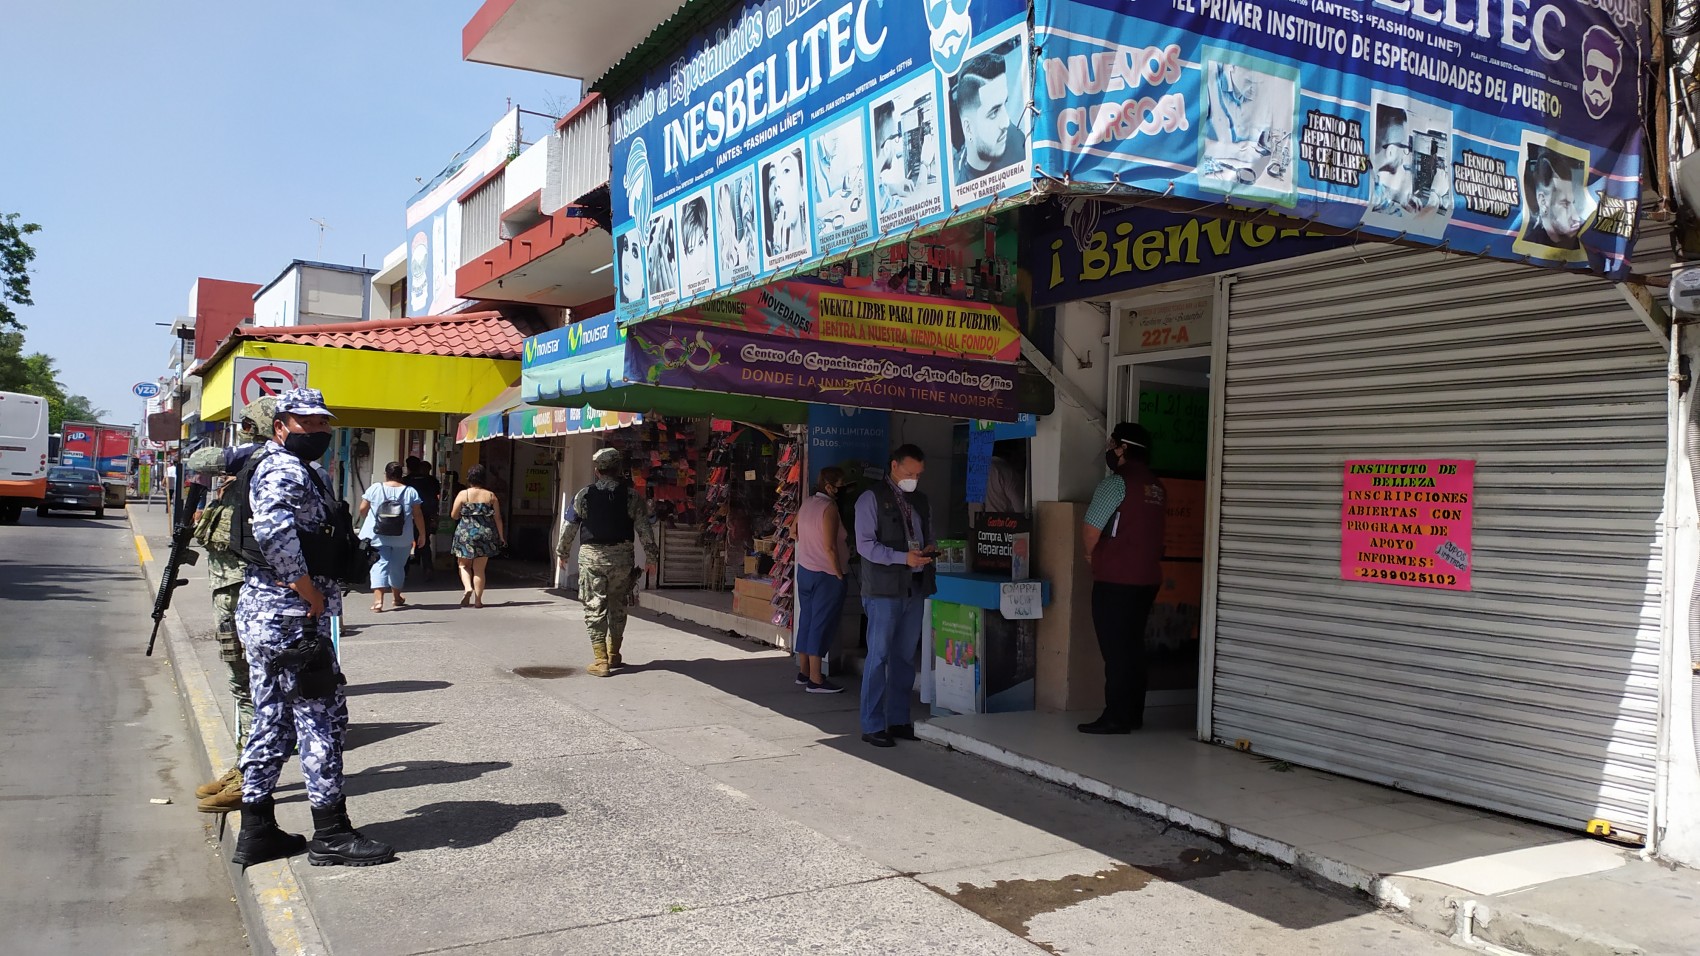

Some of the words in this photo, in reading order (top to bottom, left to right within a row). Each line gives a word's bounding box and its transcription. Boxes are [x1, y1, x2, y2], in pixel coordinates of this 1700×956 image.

[766, 5, 782, 39] en
[1311, 0, 1363, 23] (ANTES:
[1366, 14, 1424, 43] “FASHION
[1427, 33, 1462, 58] LINE”)
[1200, 0, 1262, 32] PRIMER
[1267, 9, 1347, 55] INSTITUTO
[1351, 33, 1371, 62] DE
[1373, 41, 1482, 96] ESPECIALIDADES
[1485, 75, 1508, 103] DEL
[1512, 82, 1562, 118] PUERTO!
[663, 0, 888, 176] INESBELLTEC
[1057, 93, 1189, 147] CURSOS!
[1308, 112, 1346, 136] TÉCNICO
[1349, 122, 1360, 139] EN
[716, 145, 742, 168] (ANTES:
[1301, 143, 1314, 160] DE
[1309, 161, 1315, 177] Y
[1318, 163, 1358, 186] TABLETS
[1463, 151, 1495, 173] TÉCNICO
[1496, 161, 1505, 176] EN
[956, 182, 979, 196] TÉCNICO
[980, 180, 988, 188] EN
[988, 164, 1025, 185] PELUQUERÍA
[978, 181, 1006, 197] BARBERÍA
[1504, 177, 1518, 191] DE
[1455, 179, 1519, 205] COMPUTADORAS
[898, 209, 904, 217] EN
[934, 196, 941, 204] DE
[1466, 195, 1472, 209] Y
[1473, 197, 1510, 217] LAPTOPS
[880, 215, 916, 232] COMPUTADORAS
[919, 206, 941, 219] LAPTOPS
[758, 291, 813, 334] ¡NOVEDADES!
[820, 297, 853, 317] ¡VENTA
[856, 302, 886, 320] LIBRE
[889, 304, 913, 324] PARA
[917, 307, 943, 326] TODO
[946, 310, 957, 328] EL
[959, 312, 1001, 332] PUBLICO!
[582, 324, 610, 345] movistar
[822, 320, 857, 339] ¡ENTRA
[858, 325, 866, 339] A
[868, 326, 908, 344] NUESTRA
[910, 329, 943, 346] TIENDA
[944, 332, 960, 350] (AL
[1141, 325, 1189, 347] 227-A
[536, 338, 560, 356] movistar
[741, 344, 785, 362] Centro
[786, 349, 802, 365] de
[803, 352, 881, 374] Capacitación
[901, 364, 913, 378] el
[913, 366, 946, 382] Arte
[947, 370, 961, 384] de
[961, 372, 979, 386] las
[979, 375, 1013, 391] Uñas
[137, 386, 157, 395] yza
[742, 368, 794, 385] DONDE
[798, 376, 816, 388] LA
[910, 388, 945, 402] TIENE
[1139, 392, 1159, 414] Gel
[1163, 394, 1181, 415] 21
[67, 432, 85, 442] FUD
[812, 426, 837, 436] ¡PLAN
[840, 427, 884, 437] ILIMITADO!
[1350, 464, 1427, 474] INSTITUTO
[1438, 464, 1457, 474] DE
[1372, 477, 1435, 487] BELLEZA
[1348, 490, 1468, 503] INSCRIPCIONES
[1347, 505, 1417, 518] ABIERTAS
[1432, 509, 1462, 521] CON
[1347, 520, 1423, 535] PROGRAMA
[1430, 525, 1448, 536] DE
[1370, 537, 1414, 550] APOYO
[1444, 541, 1467, 562] CUPOS
[1358, 551, 1434, 568] INFORMES:
[1361, 567, 1457, 586] 2299025102
[1002, 583, 1037, 595] COMPRA
